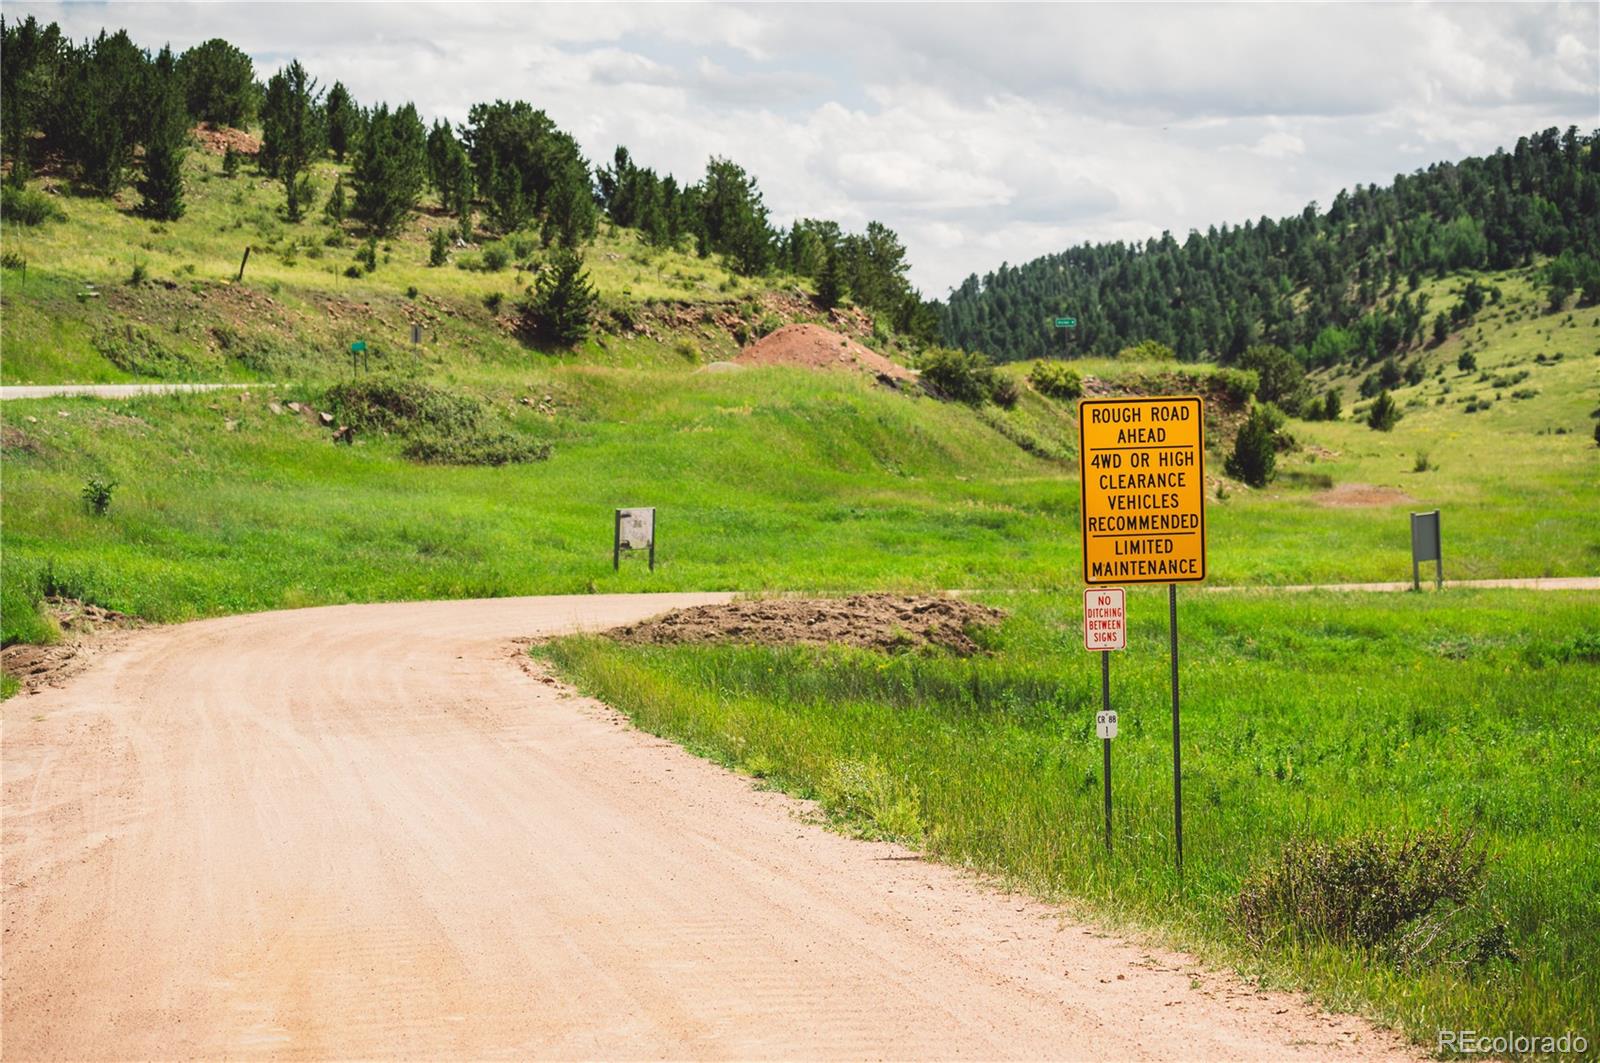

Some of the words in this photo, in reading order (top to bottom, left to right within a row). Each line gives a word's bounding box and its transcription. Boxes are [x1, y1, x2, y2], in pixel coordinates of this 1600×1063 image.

[1092, 408, 1141, 423] ROUGH
[1151, 406, 1189, 422] ROAD
[1117, 428, 1166, 443] AHEAD
[1091, 454, 1121, 469] 4WD
[1130, 453, 1149, 468] OR
[1159, 451, 1194, 467] HIGH
[1099, 472, 1186, 489] CLEARANCE
[1108, 493, 1179, 510] VEHICLES
[1088, 514, 1199, 531] RECOMMENDED
[1115, 539, 1173, 555] LIMITED
[1092, 559, 1197, 577] MAINTENANCE
[1098, 595, 1111, 606] NO
[1087, 607, 1122, 618] DITCHING
[1089, 620, 1121, 630] BETWEEN
[1093, 632, 1117, 642] SIGNS
[1097, 715, 1105, 723] CR
